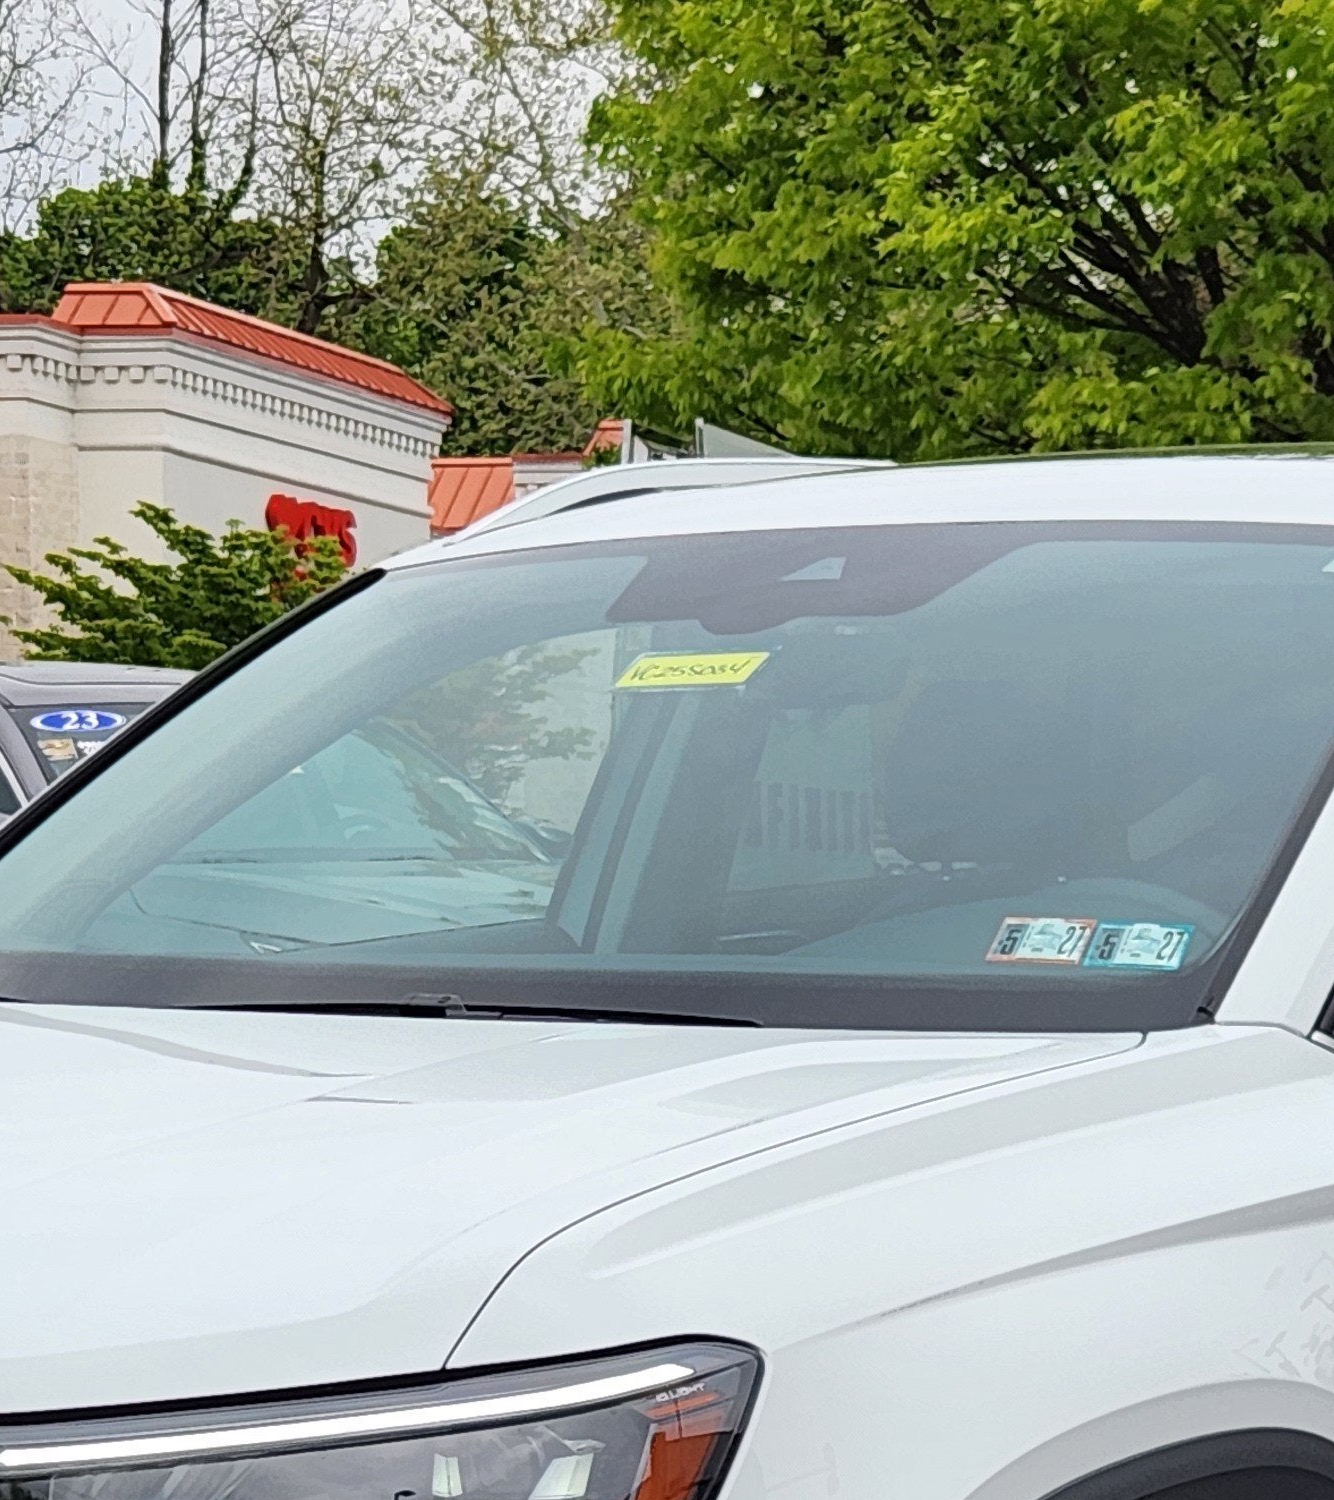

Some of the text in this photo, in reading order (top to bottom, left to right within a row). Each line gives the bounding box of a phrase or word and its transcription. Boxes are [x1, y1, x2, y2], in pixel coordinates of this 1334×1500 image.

[60, 710, 100, 730] 23
[1057, 925, 1088, 958] 27
[1155, 931, 1186, 962] 27
